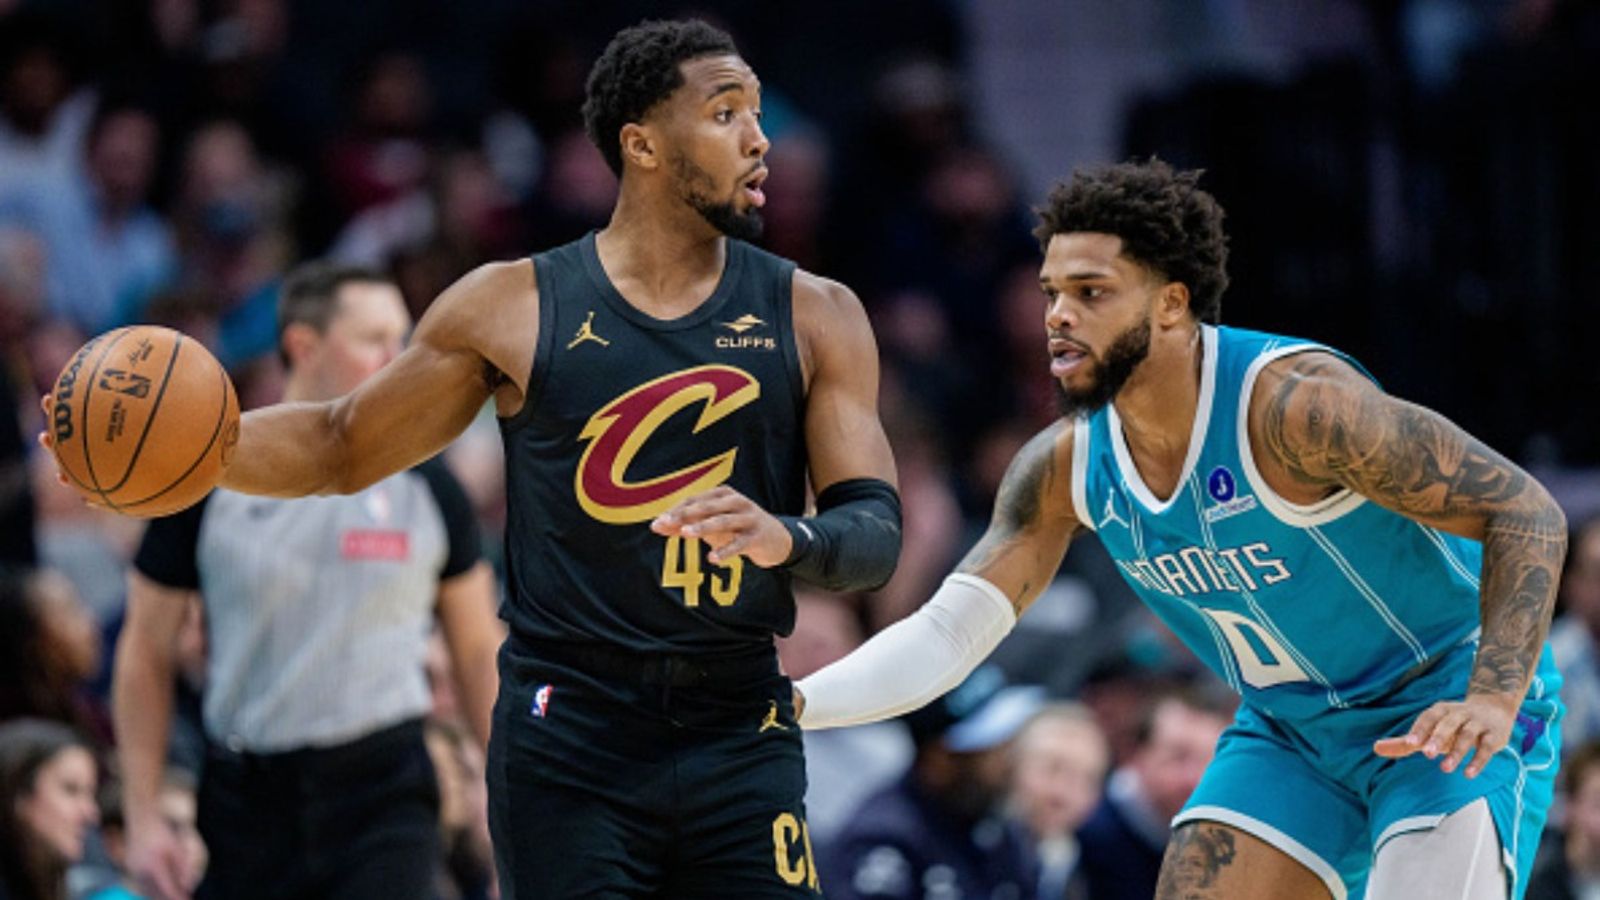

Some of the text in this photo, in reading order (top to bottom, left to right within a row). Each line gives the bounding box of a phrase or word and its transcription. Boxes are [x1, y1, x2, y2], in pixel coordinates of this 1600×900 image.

[575, 363, 761, 525] C
[661, 533, 744, 607] 45
[1200, 607, 1311, 689] 0
